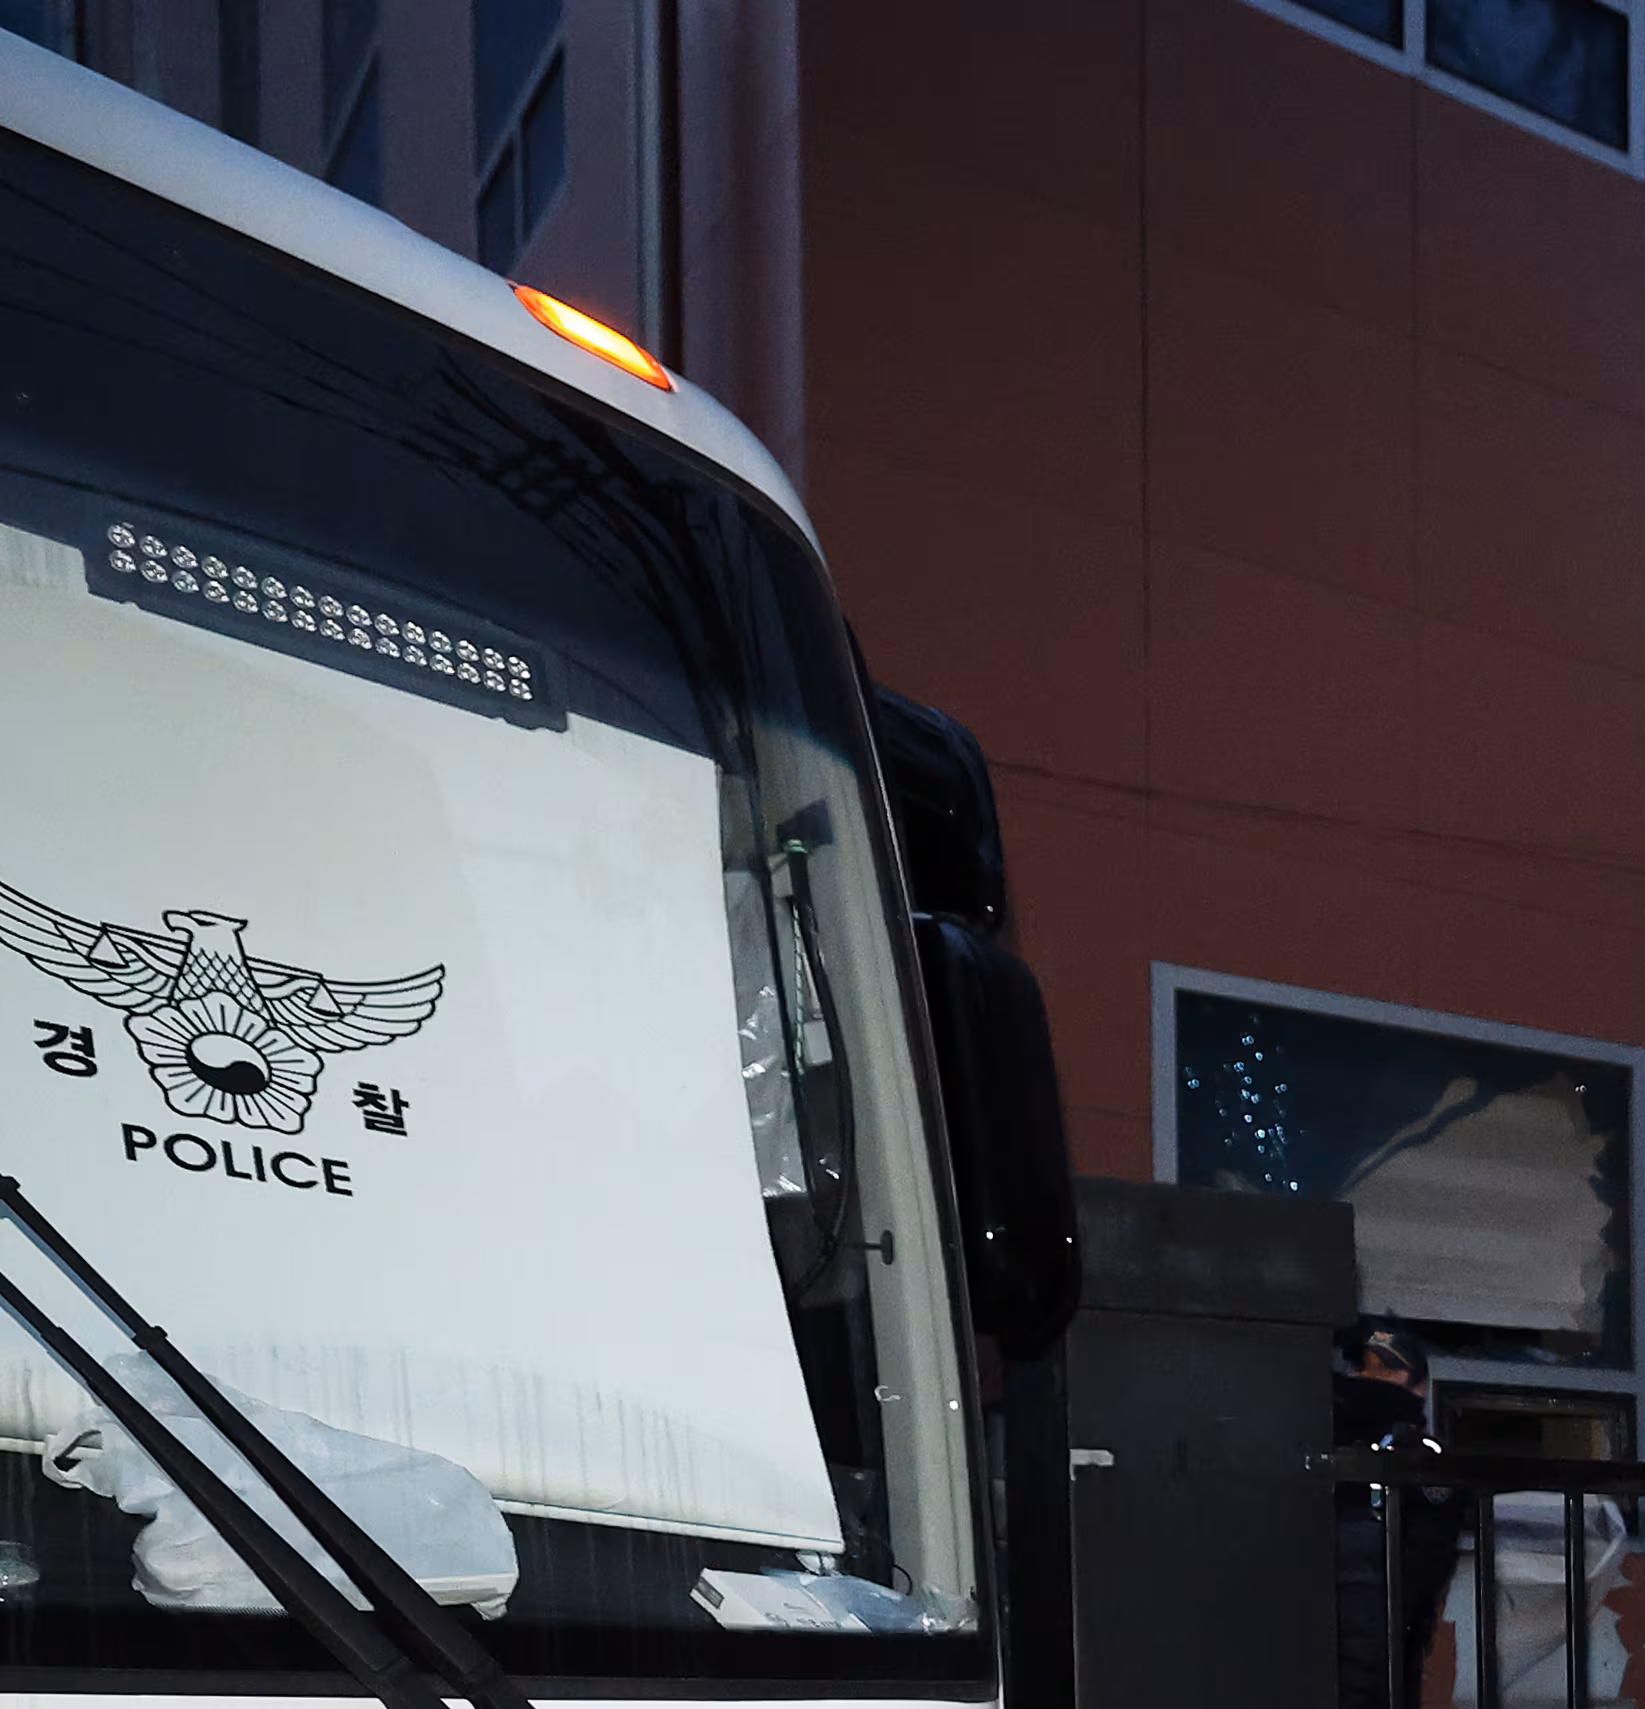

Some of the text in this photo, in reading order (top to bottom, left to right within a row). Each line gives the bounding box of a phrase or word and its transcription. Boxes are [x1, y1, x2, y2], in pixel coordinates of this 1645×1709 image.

[33, 1019, 411, 1138] 경 찰
[121, 1122, 354, 1197] POLICE
